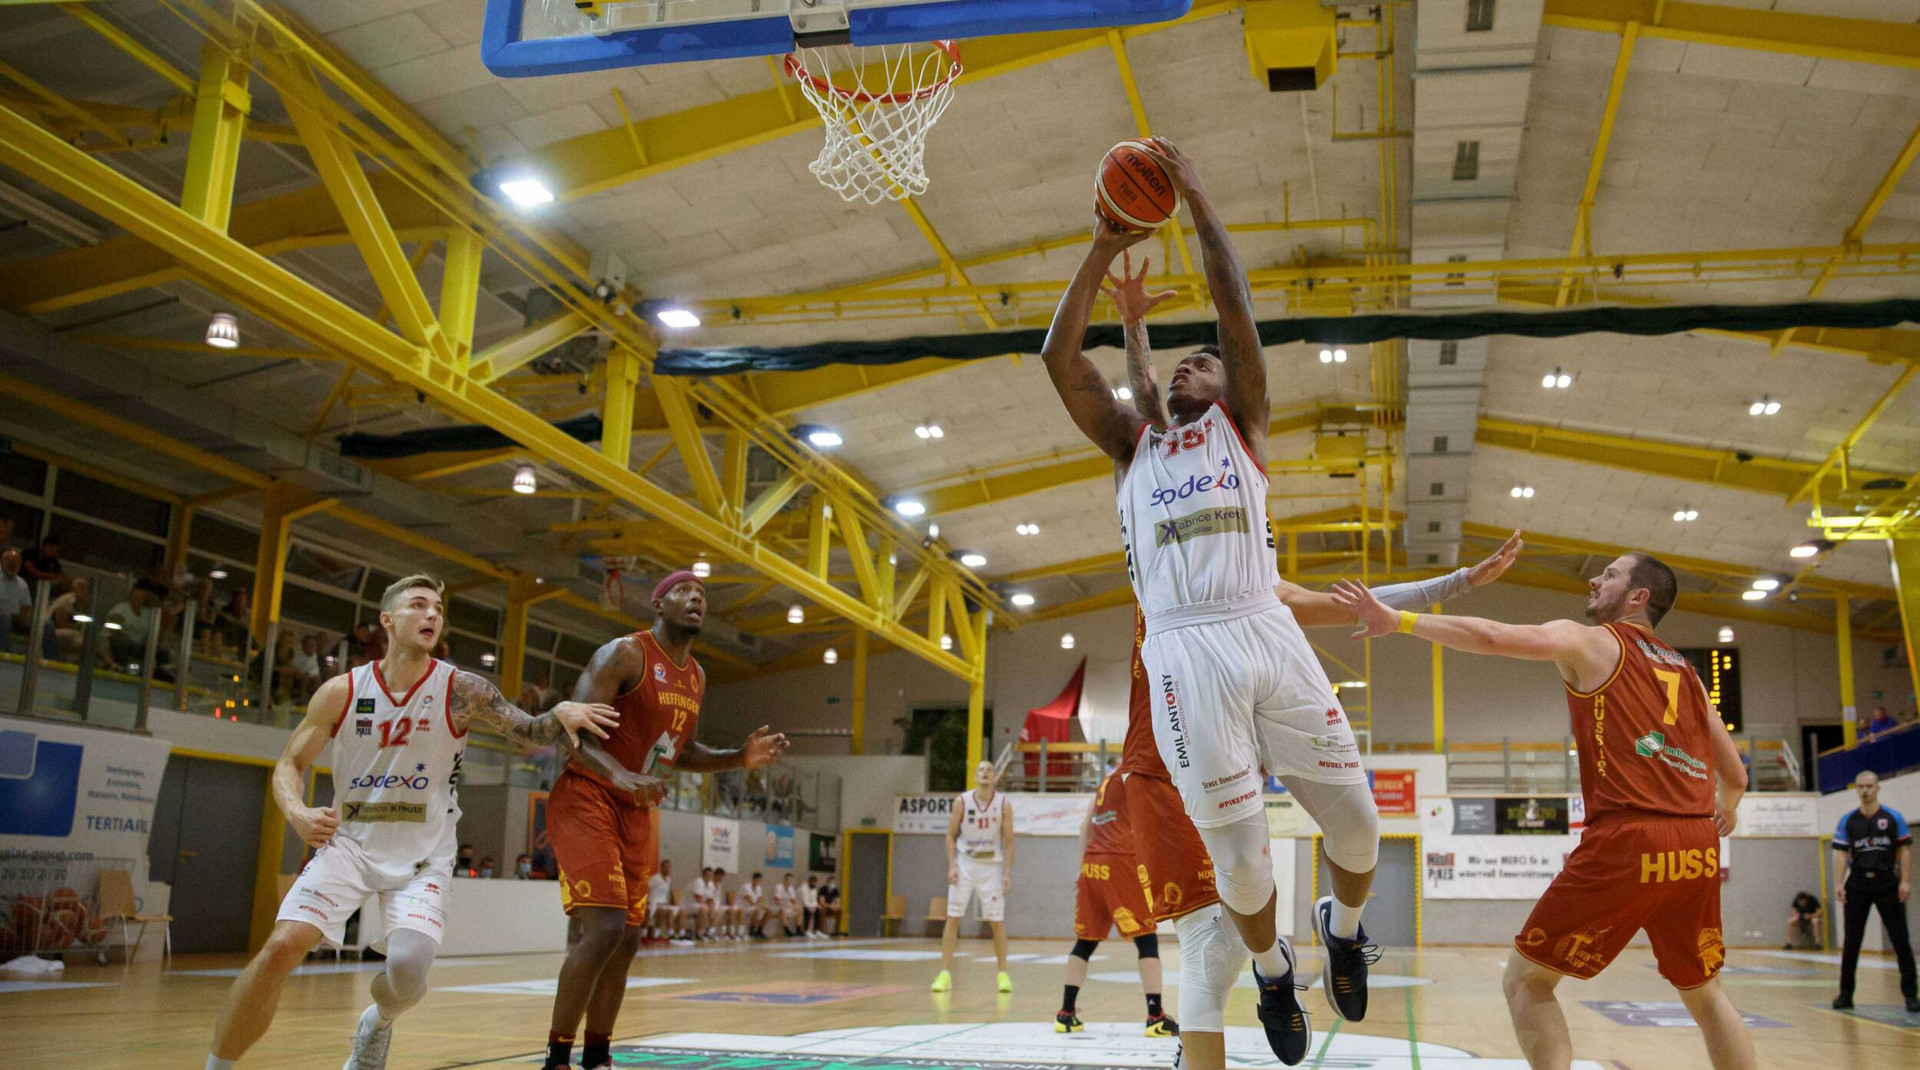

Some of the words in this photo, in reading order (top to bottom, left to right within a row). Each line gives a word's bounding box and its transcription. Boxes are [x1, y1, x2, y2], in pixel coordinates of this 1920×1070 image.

[1125, 153, 1166, 197] molten
[1150, 467, 1240, 507] sodexo
[1162, 674, 1182, 733] ANTONY
[1653, 667, 1681, 726] 7
[376, 716, 412, 749] 12
[672, 709, 688, 732] 12
[1174, 735, 1190, 768] EMIL
[349, 769, 429, 790] sodexo
[1640, 847, 1718, 884] HUSS
